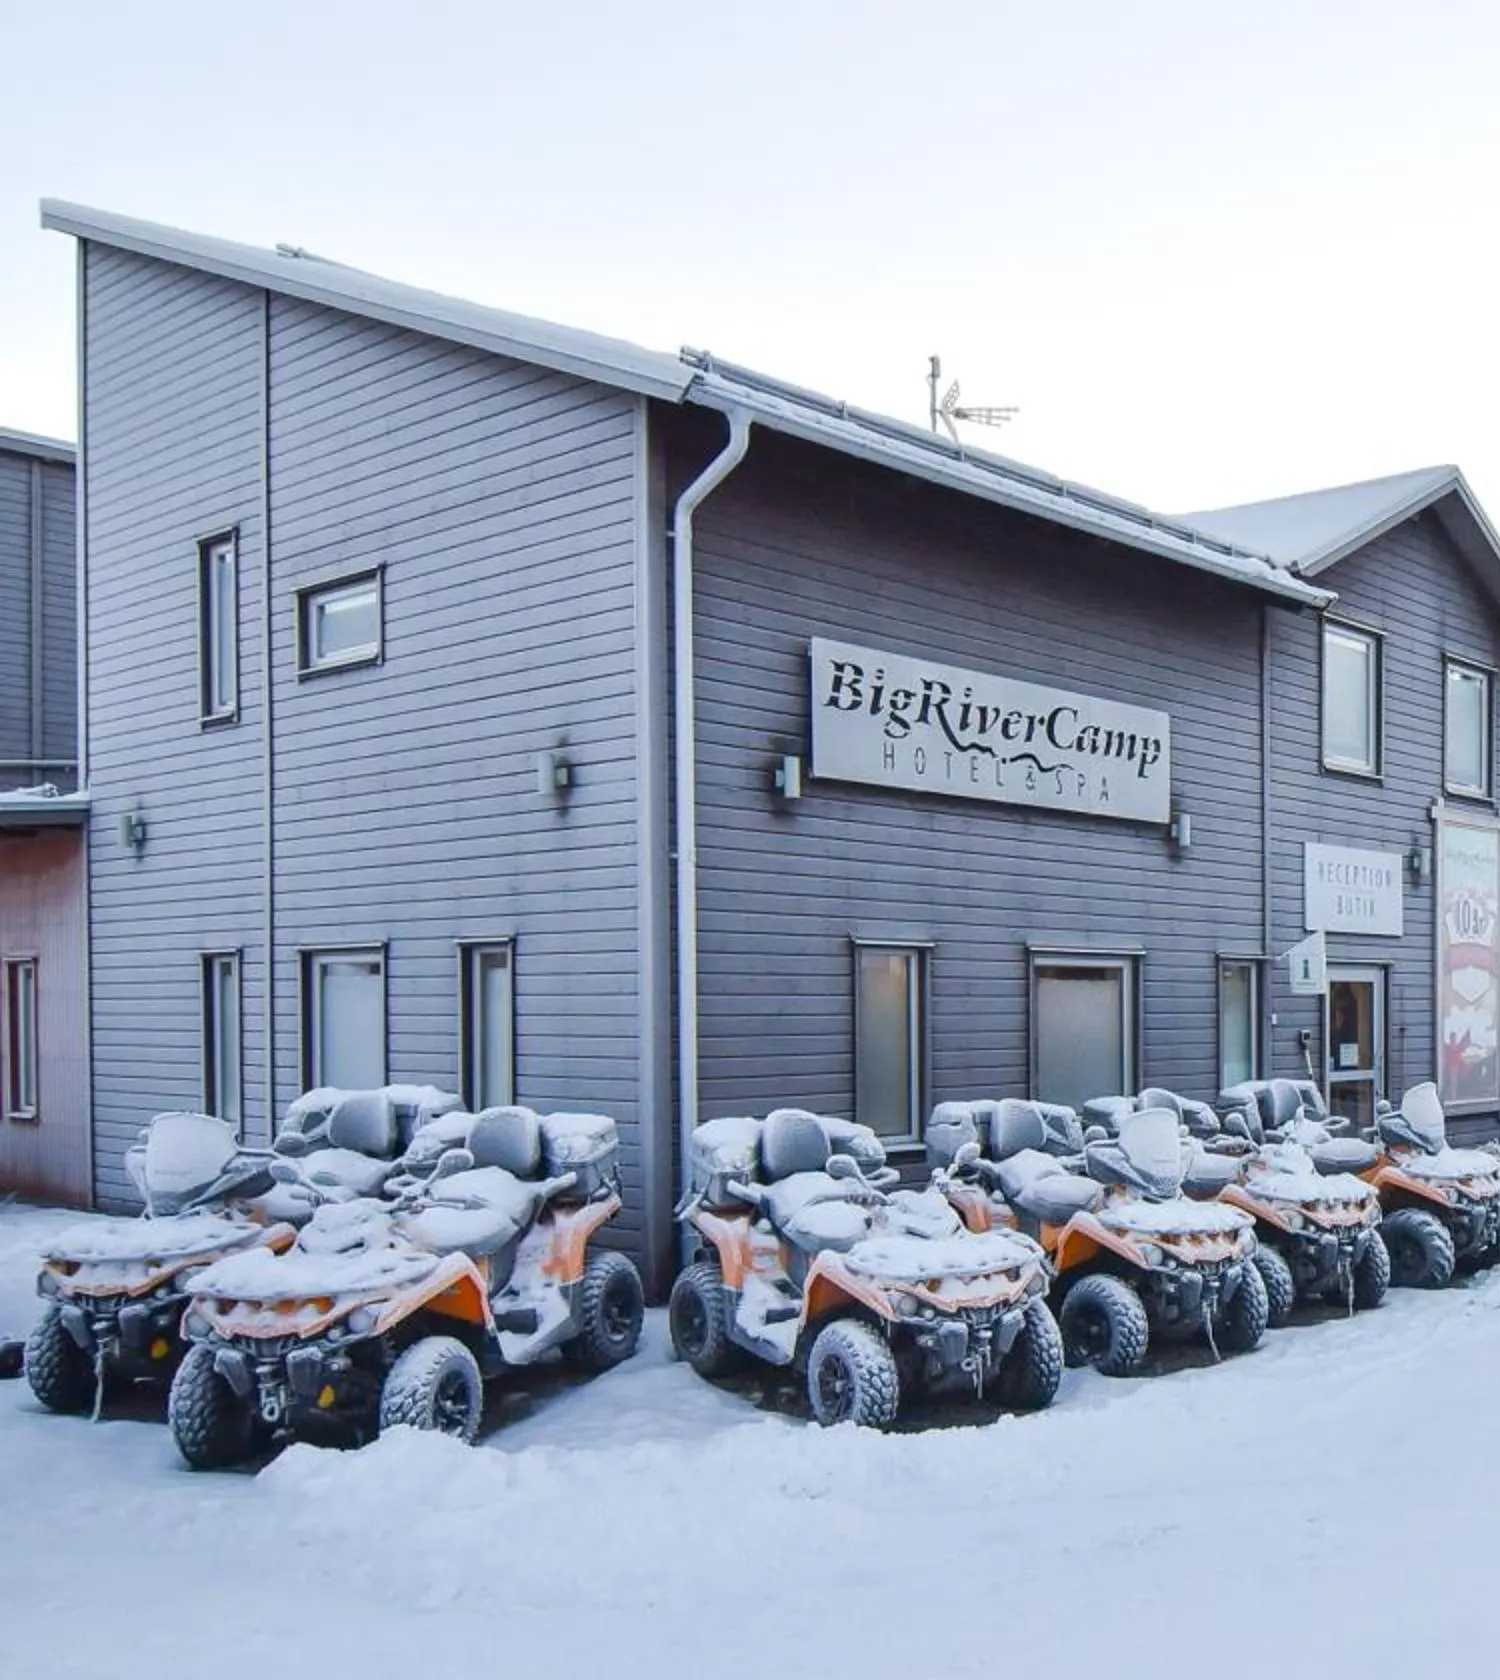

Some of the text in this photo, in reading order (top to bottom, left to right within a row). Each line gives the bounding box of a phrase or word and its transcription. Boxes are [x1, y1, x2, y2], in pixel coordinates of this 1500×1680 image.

[824, 659, 1162, 778] BigRiverCamp
[883, 742, 1004, 786] HOTEL
[1056, 770, 1109, 800] SPA
[1318, 861, 1391, 887] RECEPTION
[1337, 895, 1375, 916] BUTIK
